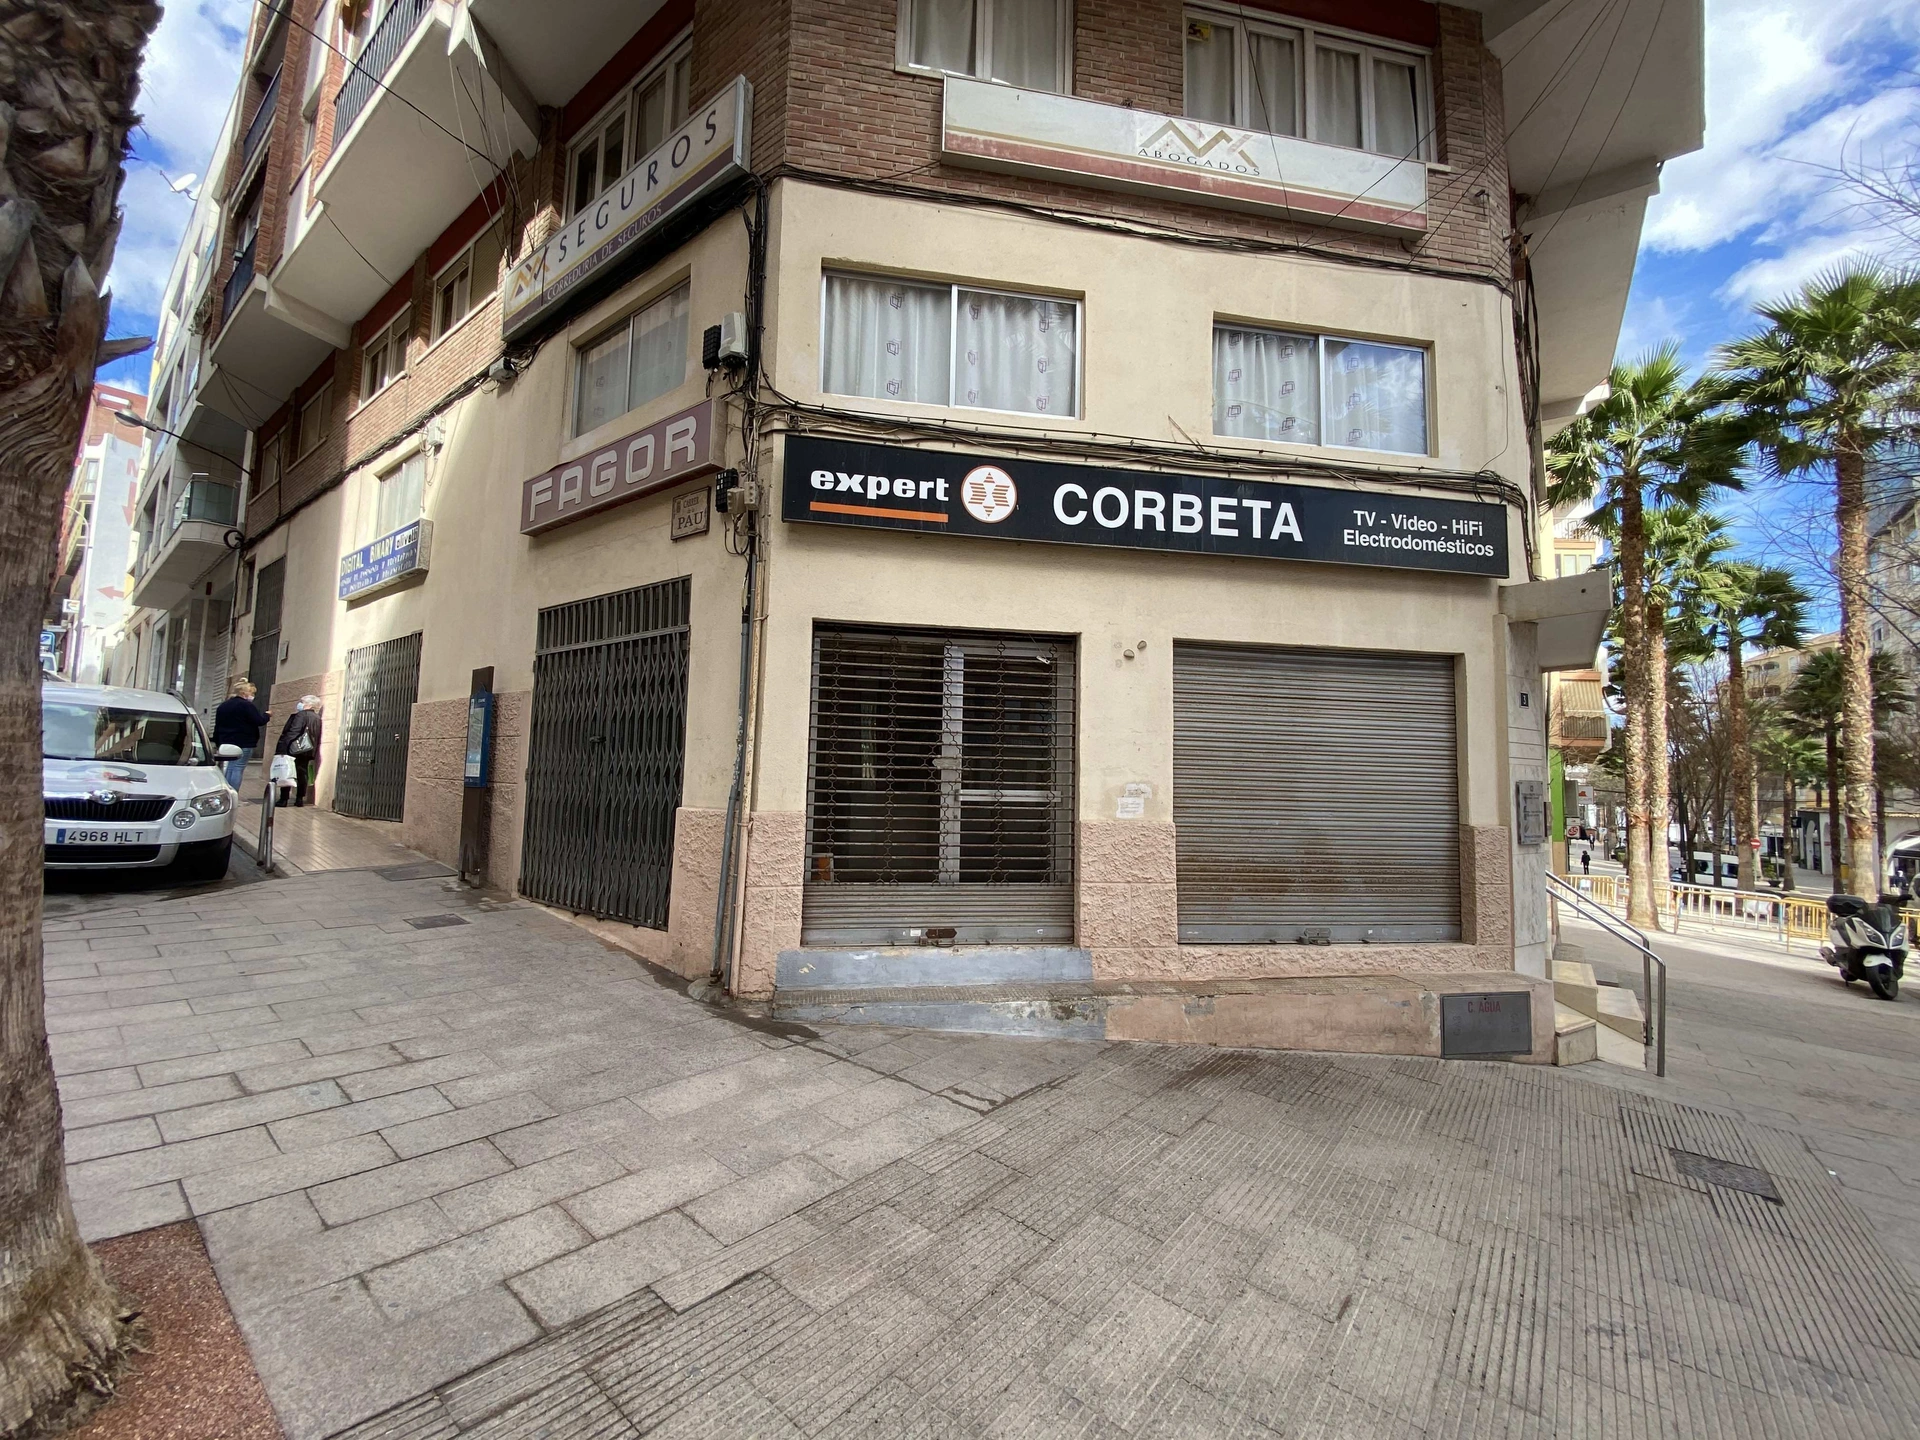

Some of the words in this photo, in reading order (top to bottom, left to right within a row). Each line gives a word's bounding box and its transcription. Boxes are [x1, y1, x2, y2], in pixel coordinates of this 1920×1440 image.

[1138, 148, 1260, 176] ABOGADOS
[558, 109, 717, 263] SEGUROS
[547, 254, 598, 300] CORREDURIA
[601, 241, 614, 260] DE
[618, 203, 662, 248] SEGUROS
[529, 415, 697, 522] FAGOR
[810, 469, 949, 502] expert
[678, 511, 704, 530] PAU
[1052, 482, 1303, 542] CORBETA
[1353, 509, 1377, 527] TV
[1391, 513, 1438, 533] Video
[1452, 519, 1483, 537] HiFi
[1343, 529, 1495, 557] Electrodomésticos
[68, 830, 109, 842] 4968
[114, 831, 144, 842] HLT
[1479, 1001, 1502, 1013] AGUA
